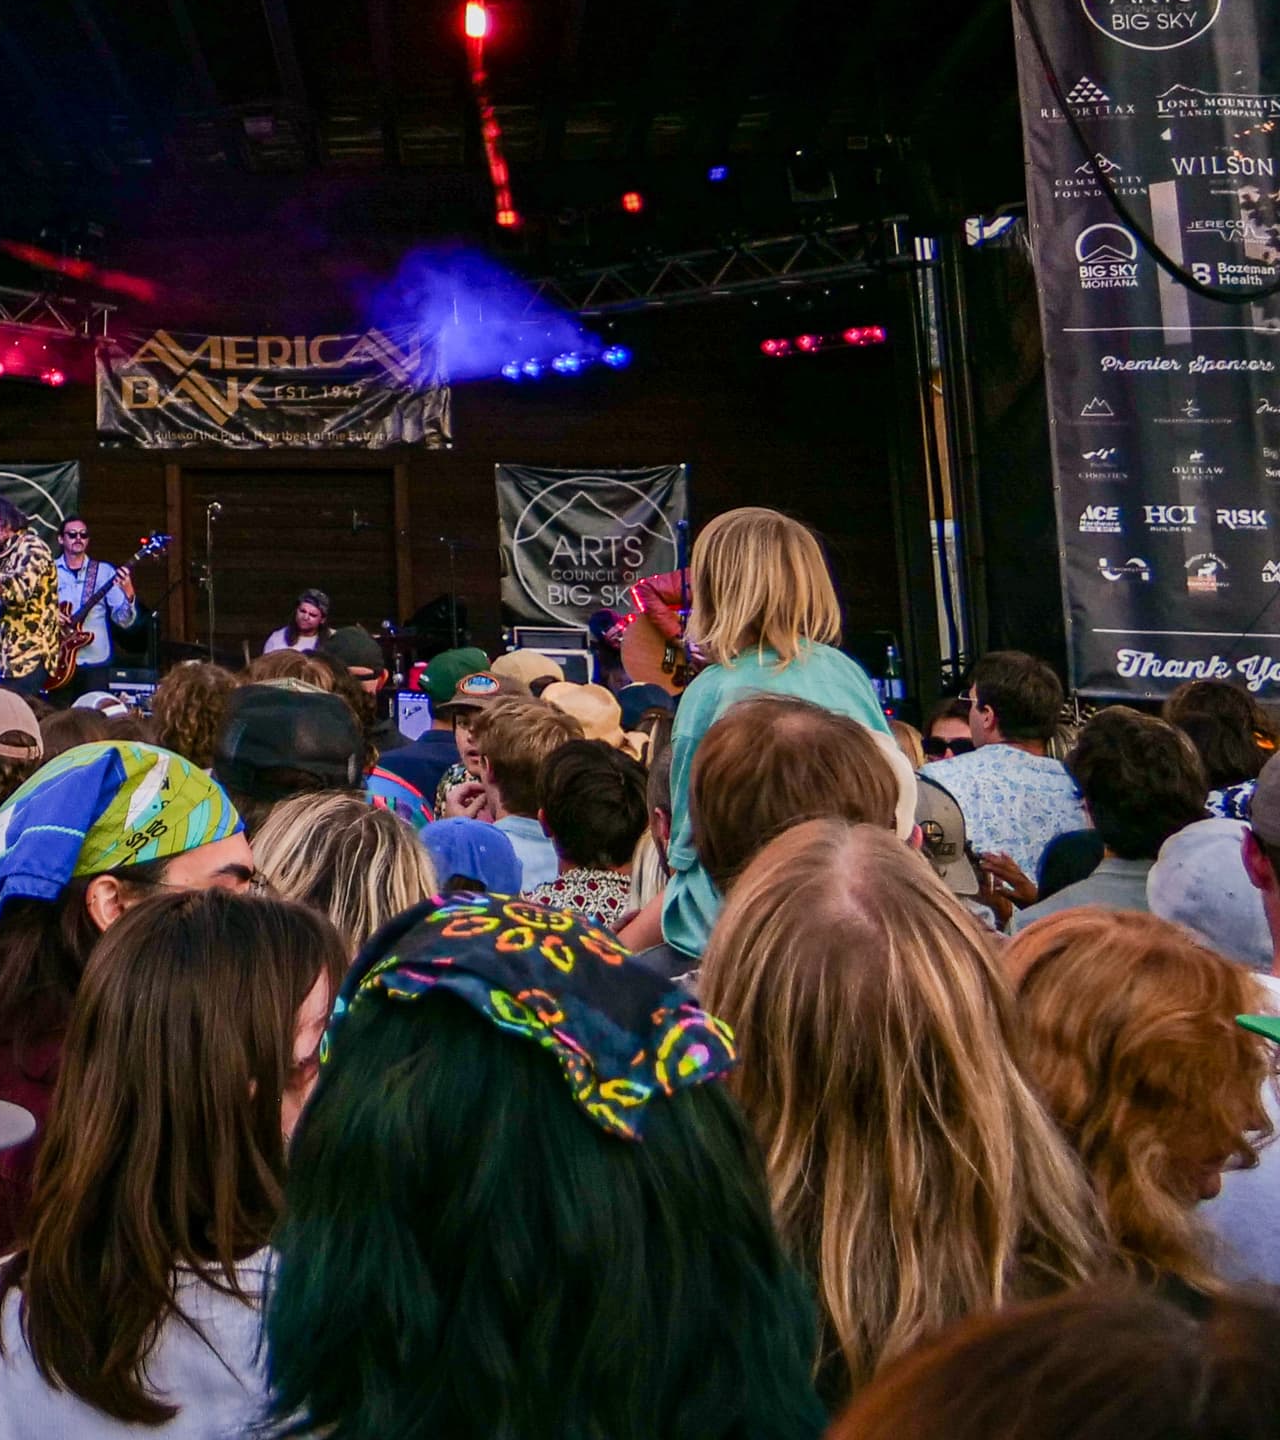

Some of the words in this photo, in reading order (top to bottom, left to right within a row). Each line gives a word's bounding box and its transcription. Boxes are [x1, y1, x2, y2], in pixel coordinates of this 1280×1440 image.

[1111, 13, 1150, 30] BIG
[1157, 11, 1197, 30] SKY
[1157, 99, 1198, 113] LONE
[1180, 109, 1212, 117] LAND
[1216, 109, 1264, 118] COMPANY
[1171, 156, 1273, 176] WILSON
[1188, 220, 1246, 229] JERECO
[1079, 264, 1108, 278] BIG
[1110, 263, 1139, 276] SKY
[1218, 262, 1276, 276] Bozeman
[1081, 278, 1139, 289] MONTANA
[1219, 274, 1263, 286] Health
[120, 329, 421, 384] AMERICAN
[1100, 356, 1182, 372] Premier
[1189, 355, 1275, 372] Sponsors
[121, 369, 268, 427] BANK
[1172, 466, 1224, 475] OUTLAW
[1080, 504, 1120, 520] ACE
[1143, 505, 1197, 524] HCI
[1216, 509, 1267, 530] RISK
[548, 535, 644, 566] ARTS
[551, 569, 617, 582] COUNCIL
[547, 585, 591, 606] BIG
[600, 585, 631, 607] SK
[1116, 648, 1232, 678] Thank
